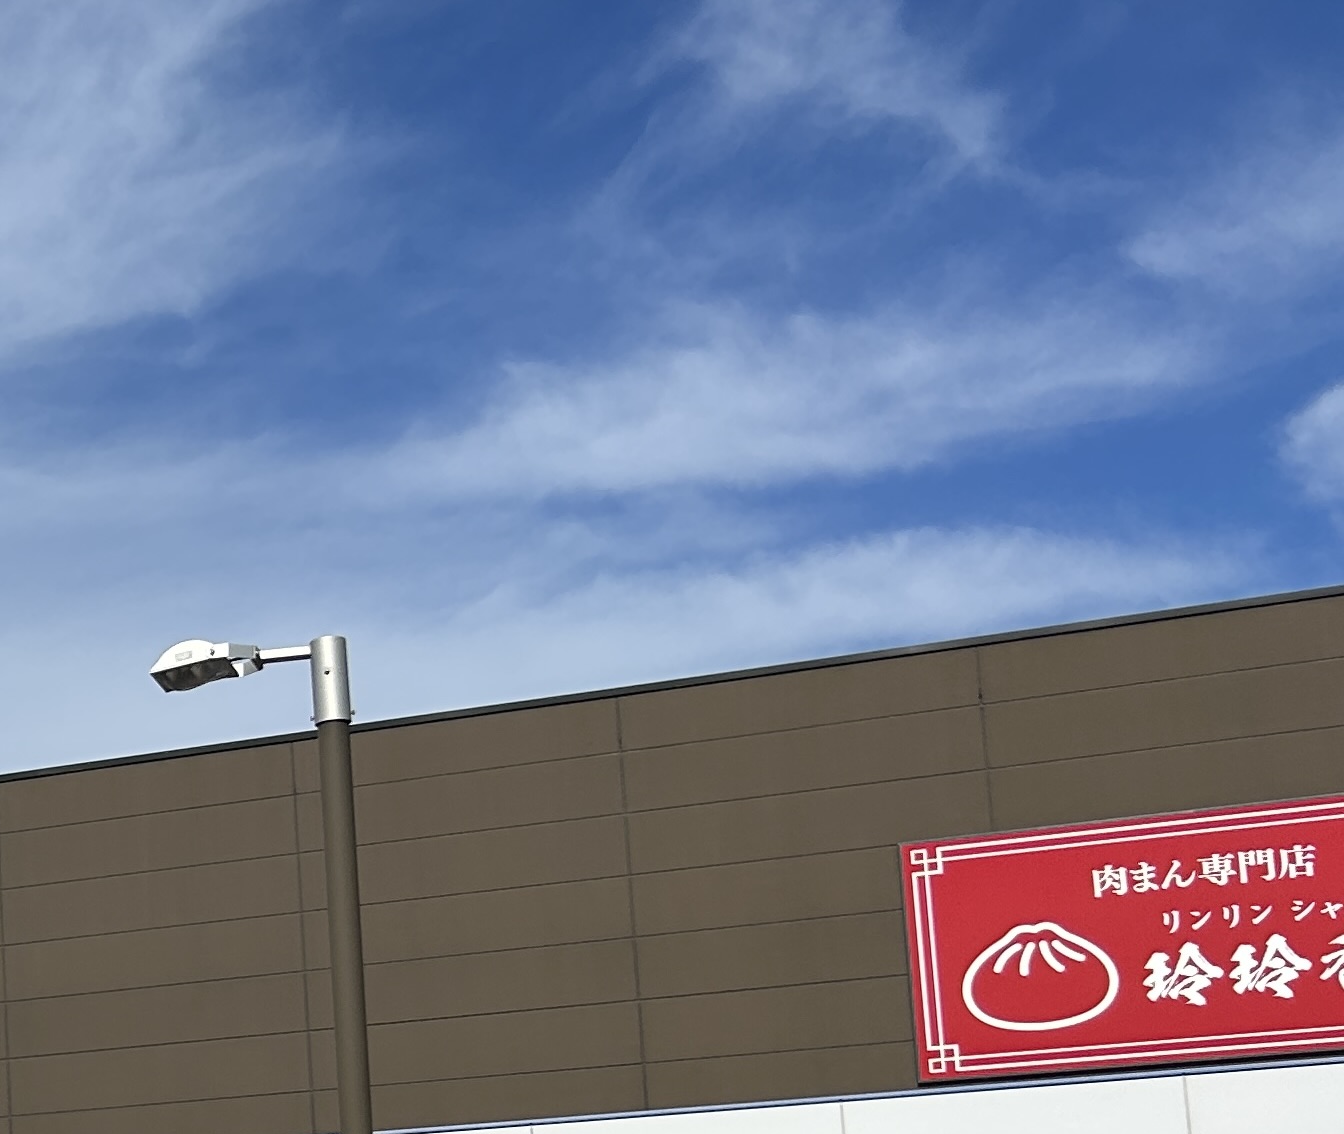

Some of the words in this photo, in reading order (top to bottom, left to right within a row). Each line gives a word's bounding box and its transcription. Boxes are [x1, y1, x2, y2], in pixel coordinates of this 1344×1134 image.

[1092, 844, 1316, 898] 肉まん専門店
[1162, 905, 1273, 933] リンリン
[1143, 934, 1344, 1006] 玲玲
